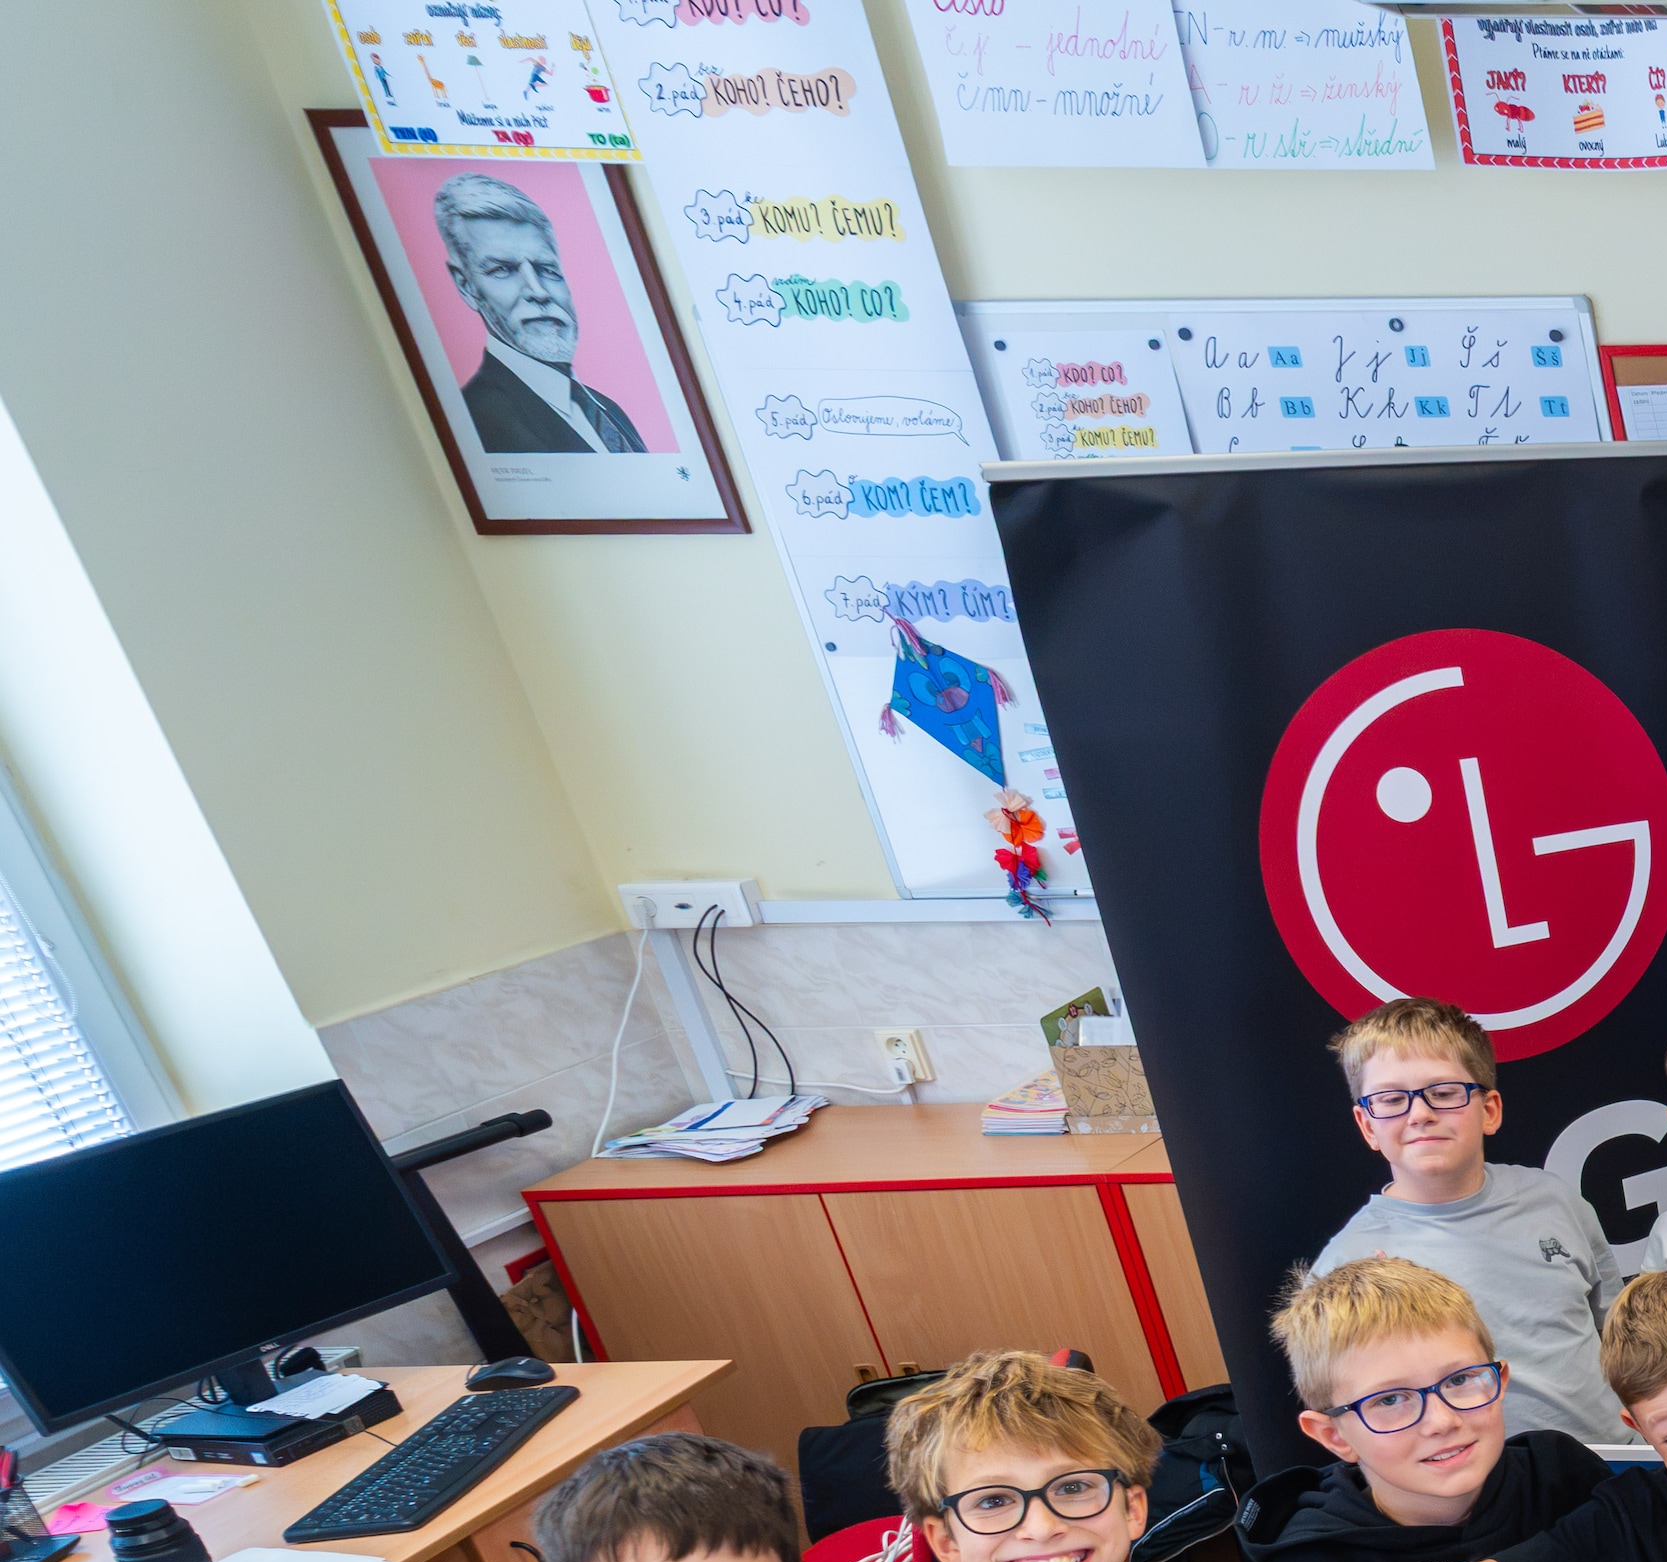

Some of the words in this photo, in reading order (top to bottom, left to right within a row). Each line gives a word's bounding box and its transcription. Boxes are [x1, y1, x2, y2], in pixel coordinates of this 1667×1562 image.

[759, 202, 824, 236] KOMU?
[831, 200, 897, 237] ČEMU?
[791, 286, 853, 317] KOHO?
[860, 286, 898, 318] CO?
[860, 481, 914, 513] KOM?
[919, 481, 973, 514] ČEM?
